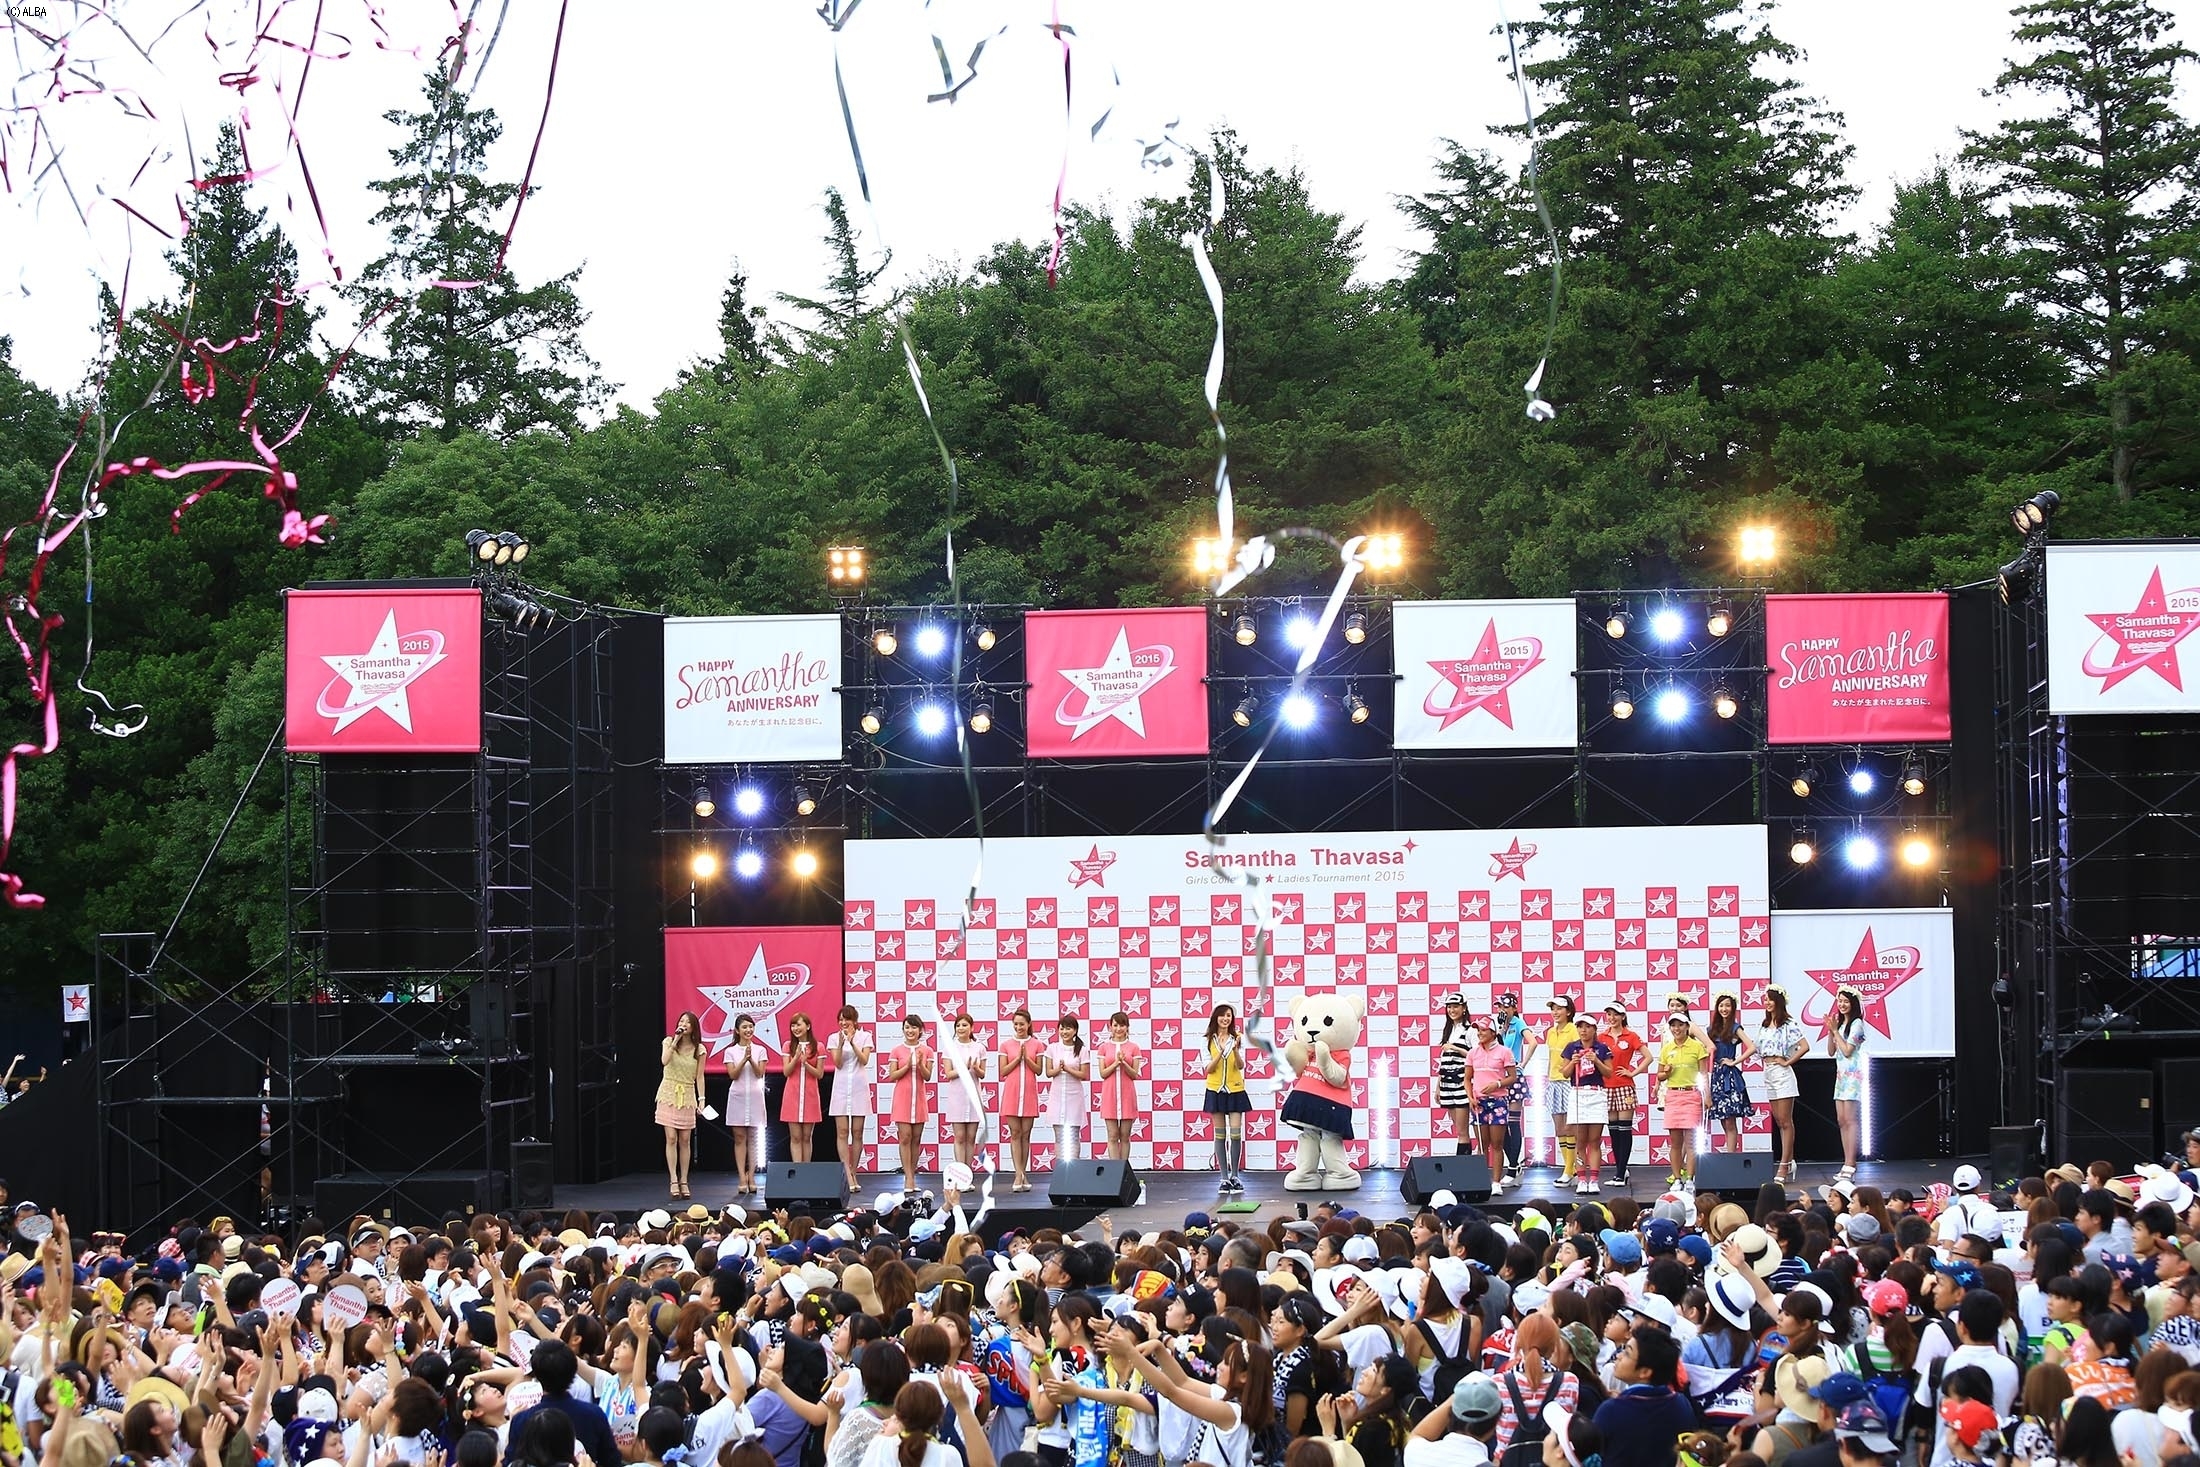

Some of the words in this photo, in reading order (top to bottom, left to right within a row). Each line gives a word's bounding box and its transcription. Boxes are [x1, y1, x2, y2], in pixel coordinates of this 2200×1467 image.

[2171, 597, 2199, 608] 2015
[2115, 614, 2181, 628] Samantha
[2121, 628, 2175, 640] Thavasa
[403, 640, 430, 651] 2015
[1503, 645, 1529, 656] 2015
[1801, 637, 1840, 651] HAPPY
[350, 656, 411, 669] Samantha
[1135, 653, 1160, 665] 2015
[1778, 629, 1938, 689] Samantha
[698, 660, 735, 672] HAPPY
[1454, 660, 1512, 673] Samantha
[355, 670, 406, 681] Thavasa
[676, 651, 830, 710] Samantha
[1086, 669, 1143, 682] Samantha
[1459, 673, 1507, 683] Thavasa
[1091, 681, 1139, 692] Thavasa
[1831, 674, 1928, 692] ANNIVERSARY
[727, 694, 820, 713] ANNIVERSARY
[1185, 849, 1296, 868] Samantha
[1310, 848, 1404, 866] Thavasa
[1185, 876, 1209, 885] Girls
[1277, 873, 1310, 883] Ladies
[1312, 873, 1370, 883] Tournament
[1374, 870, 1405, 882] 2015
[1881, 955, 1907, 965] 2015
[771, 971, 797, 983] 2015
[1832, 970, 1890, 983] Samantha
[724, 986, 780, 999] Samantha
[729, 999, 775, 1009] Thavasa
[262, 1284, 297, 1305] Samantha
[268, 1291, 297, 1309] Thavasa
[329, 1291, 366, 1312] Samantha
[330, 1300, 360, 1317] Thavasa
